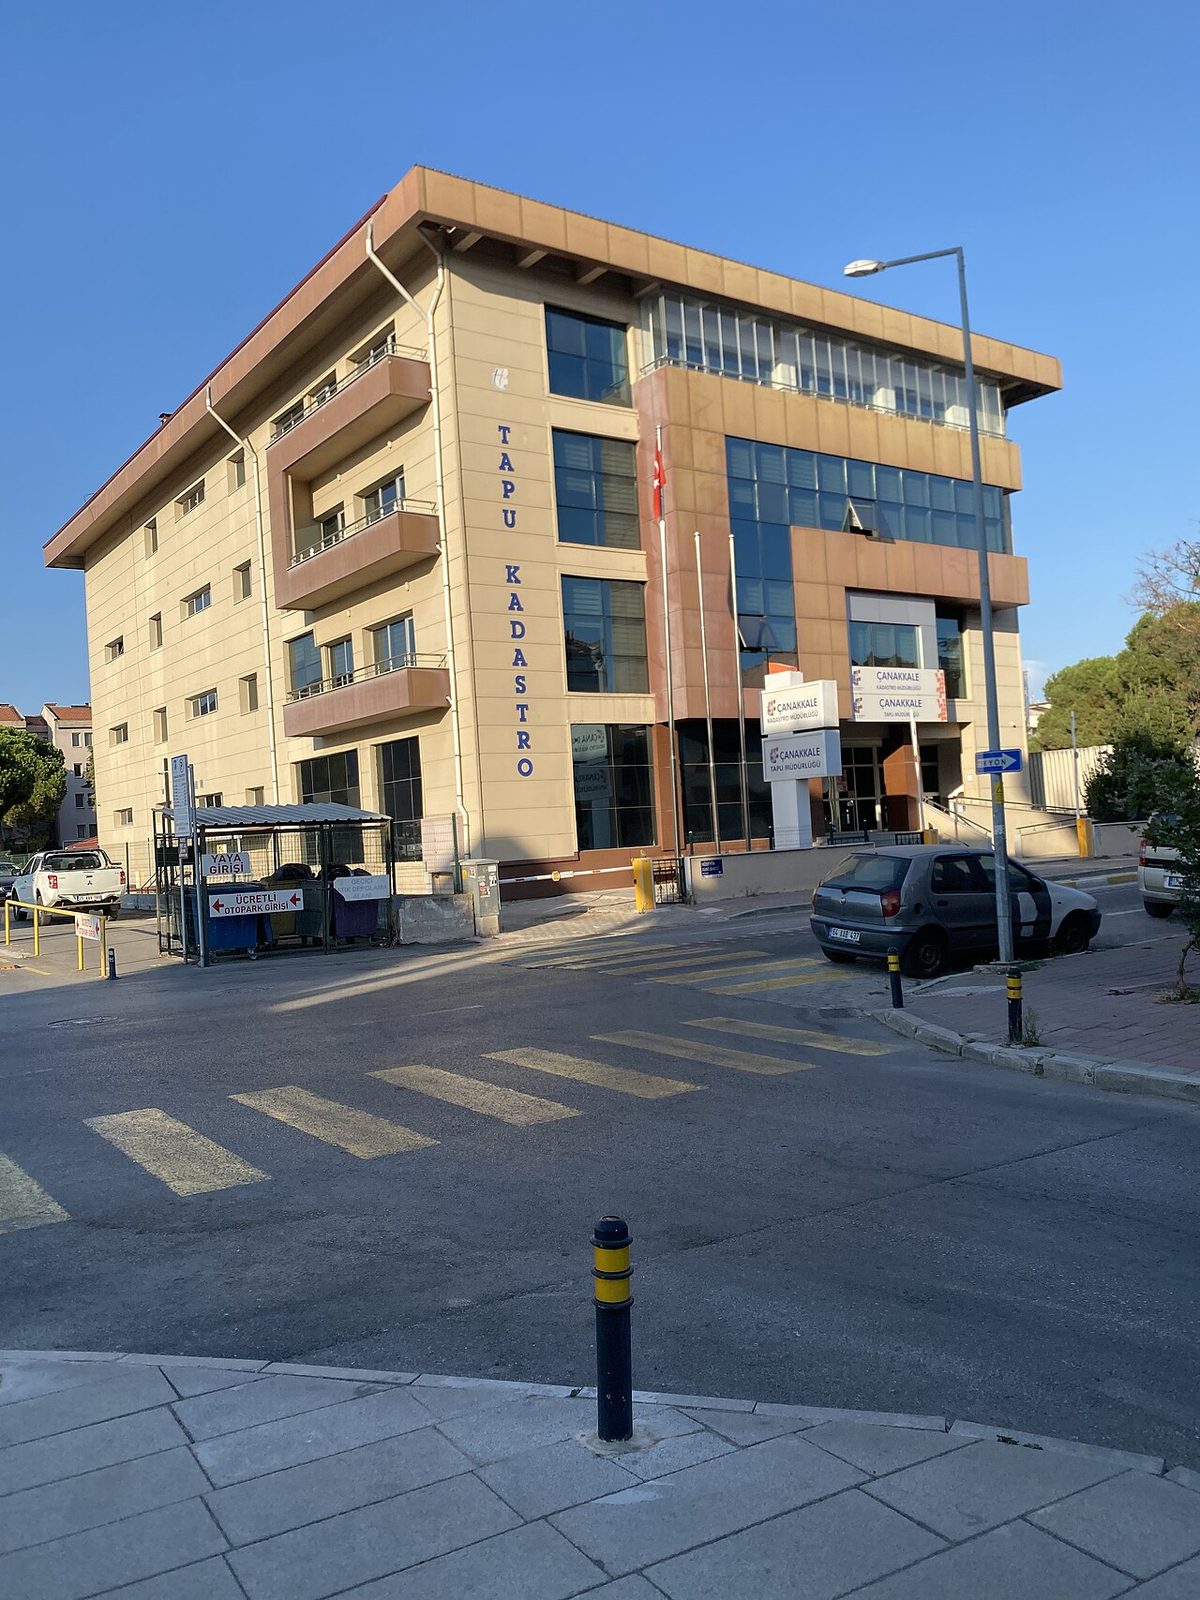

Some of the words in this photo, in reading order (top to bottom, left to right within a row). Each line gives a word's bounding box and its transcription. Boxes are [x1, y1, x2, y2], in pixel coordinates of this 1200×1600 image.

[498, 425, 517, 529] TAPU
[505, 564, 534, 778] KADASTRO
[876, 671, 920, 683] ÇANAKKALE
[777, 697, 818, 715] ÇANAKKALE
[879, 698, 922, 710] ÇANAKKALE
[779, 747, 821, 762] ÇANAKKALE
[770, 764, 784, 772] TAPU
[785, 759, 821, 771] MÜDÜRLÜĞÜ
[211, 853, 242, 863] YAYA
[210, 861, 244, 874] GİRİŞİ
[236, 891, 277, 905] ÜCRETLİ
[224, 904, 263, 915] OTOPARK
[264, 901, 289, 911] GİRİŞİ
